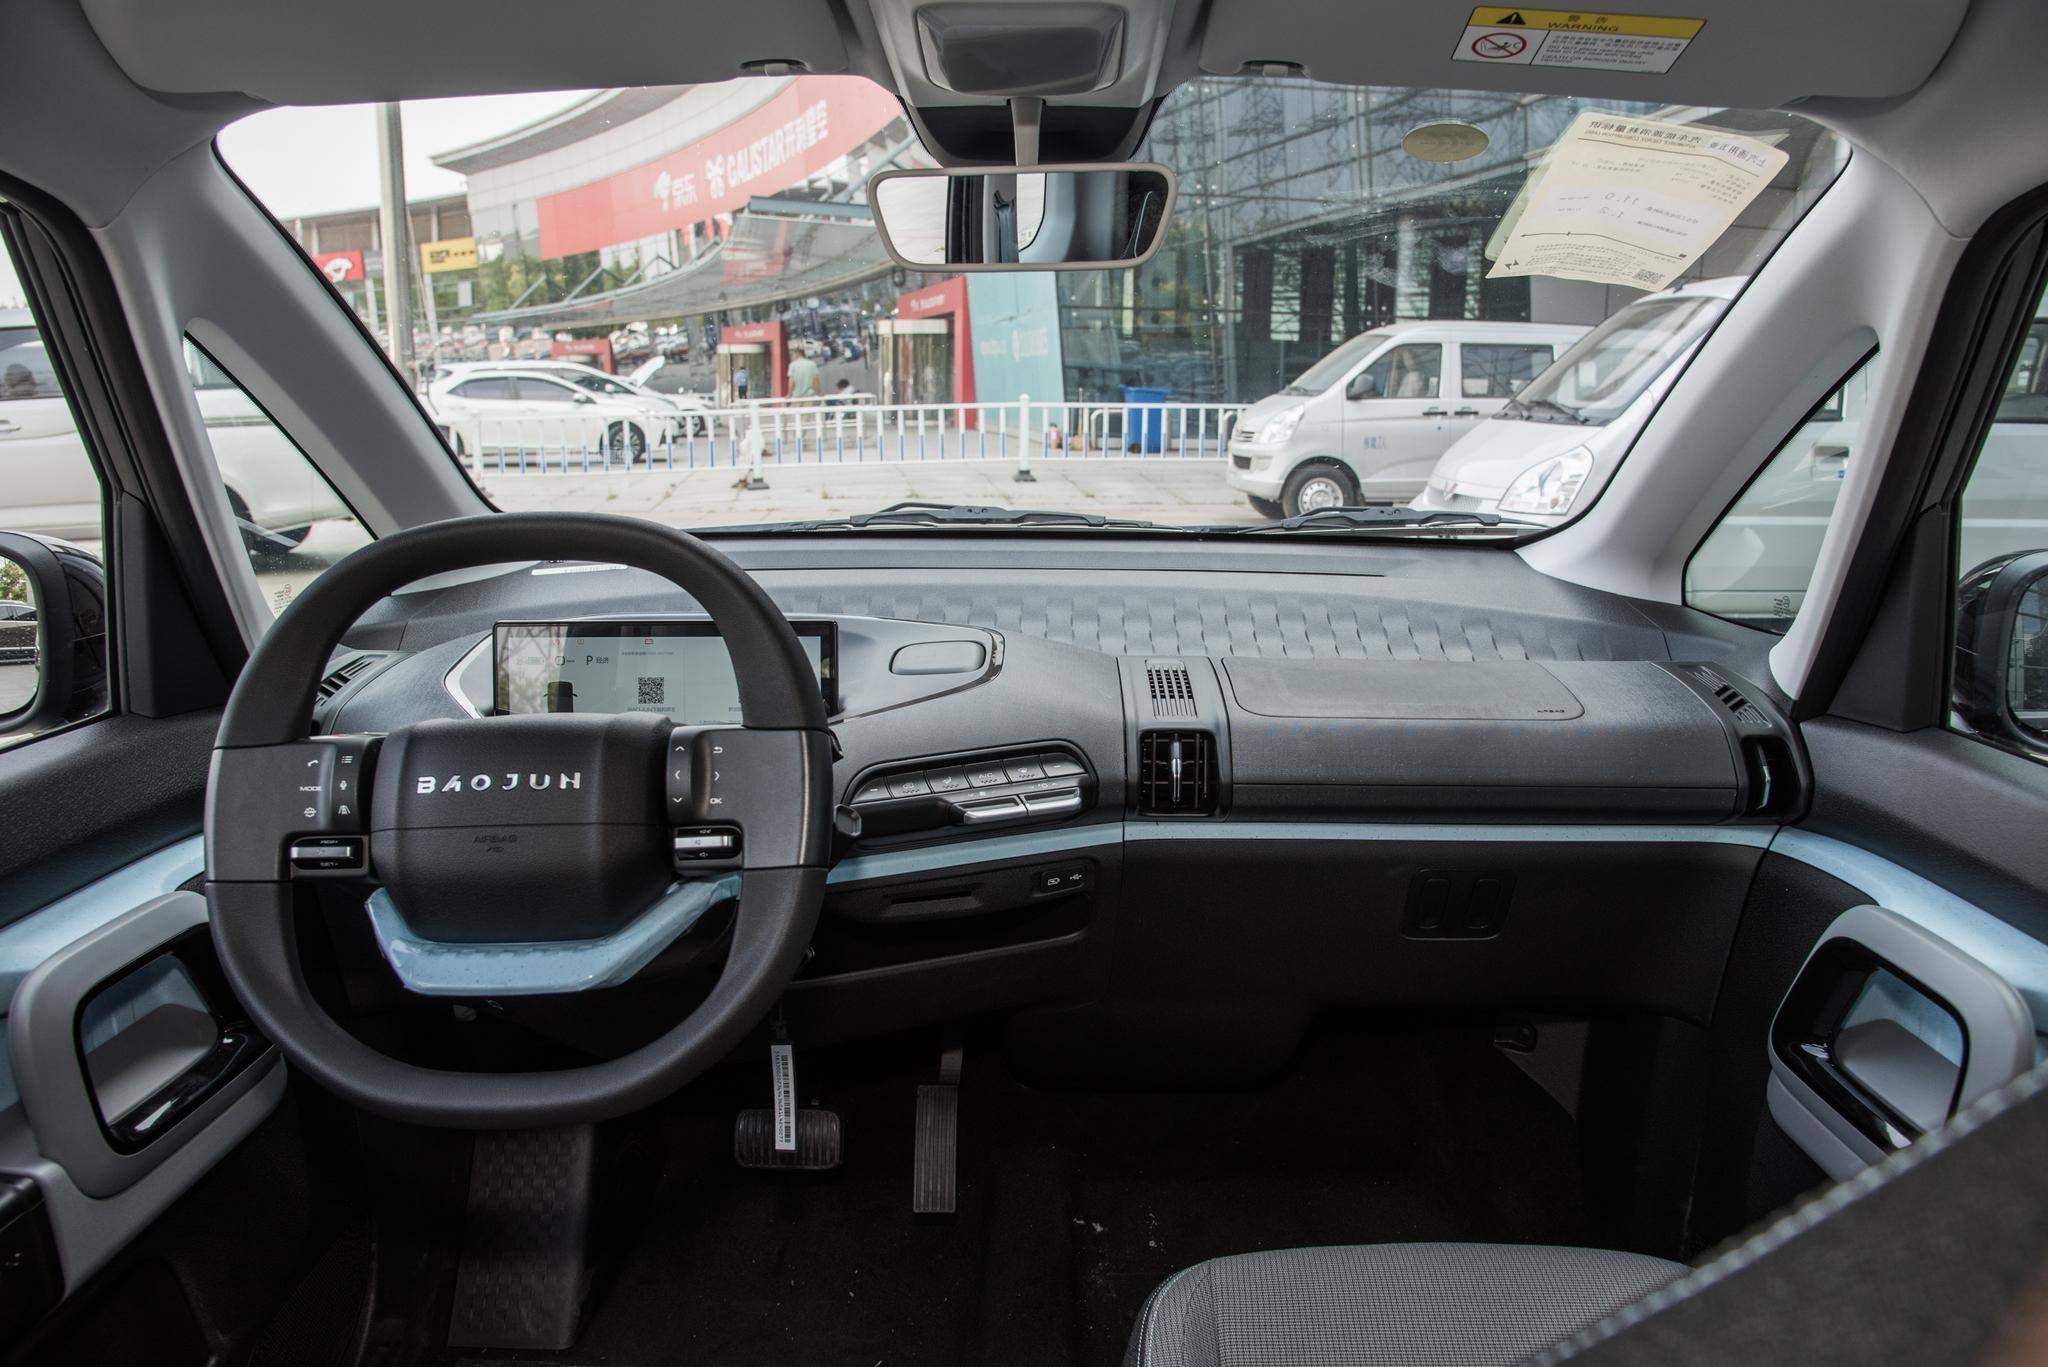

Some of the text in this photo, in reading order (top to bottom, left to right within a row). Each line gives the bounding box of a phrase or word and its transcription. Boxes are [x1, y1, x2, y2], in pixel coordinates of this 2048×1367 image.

[1547, 22, 1620, 31] WARNING
[672, 173, 697, 209] 京东
[586, 655, 593, 665] P
[978, 772, 993, 780] A/C
[416, 771, 581, 794] BAOJUN
[709, 797, 722, 805] OK
